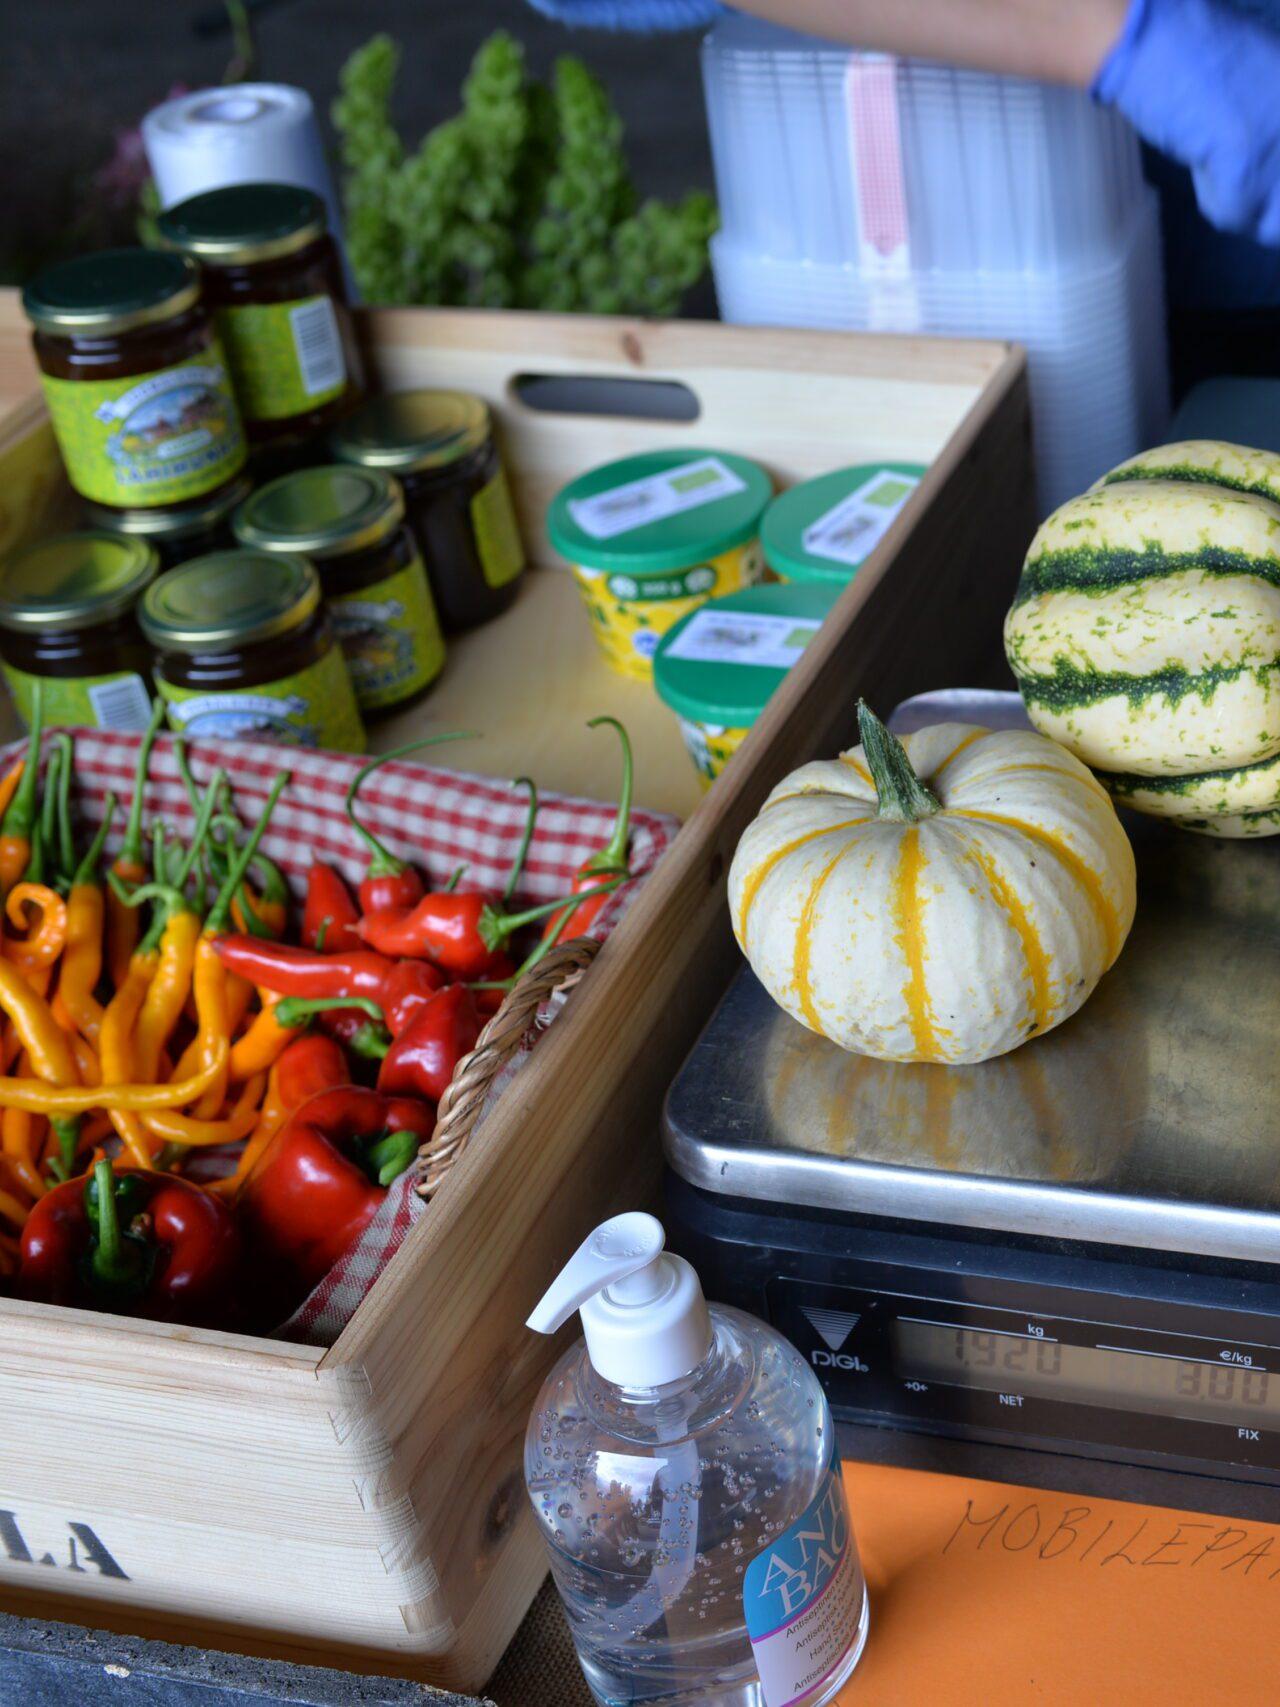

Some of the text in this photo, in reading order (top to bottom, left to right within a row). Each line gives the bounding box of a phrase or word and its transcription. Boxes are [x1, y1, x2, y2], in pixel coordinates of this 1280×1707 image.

[1028, 1324, 1044, 1337] kg
[812, 1350, 860, 1371] DIGI
[1220, 1350, 1252, 1366] €/kg
[1000, 1394, 1024, 1407] NET
[1238, 1428, 1259, 1441] FIX
[809, 1633, 833, 1661] Hand
